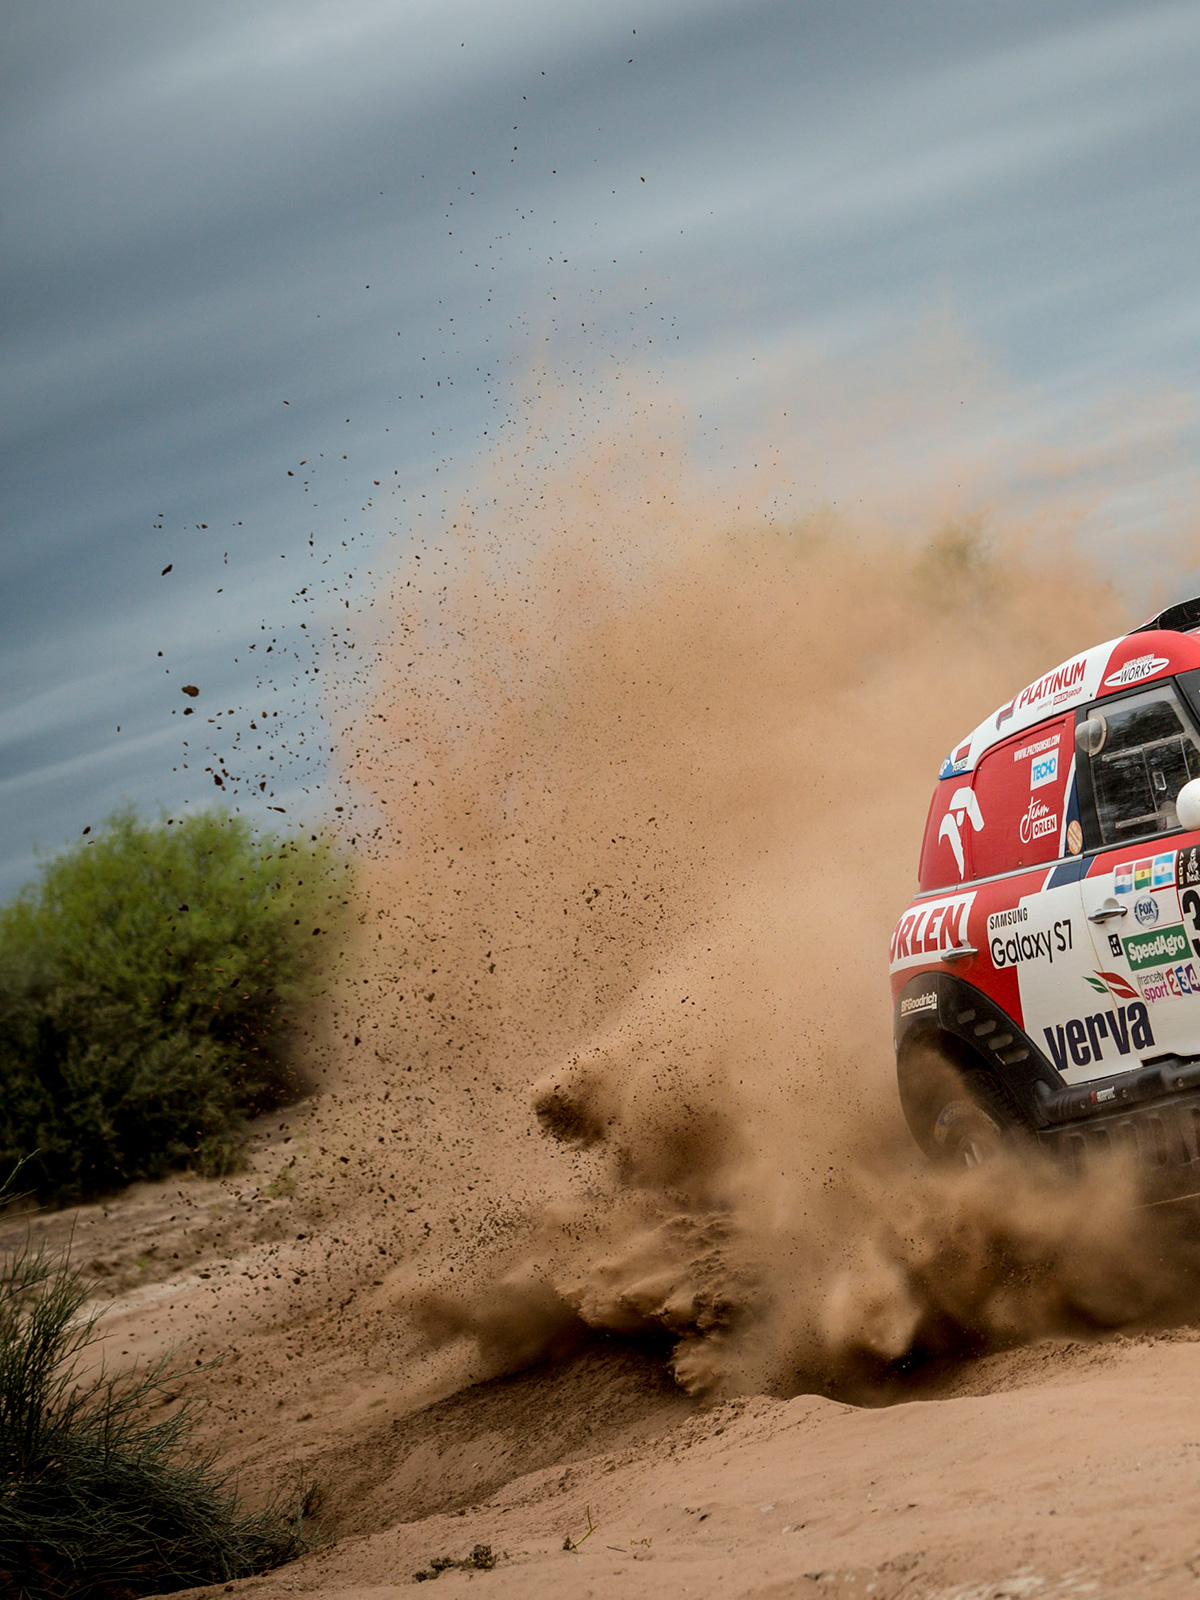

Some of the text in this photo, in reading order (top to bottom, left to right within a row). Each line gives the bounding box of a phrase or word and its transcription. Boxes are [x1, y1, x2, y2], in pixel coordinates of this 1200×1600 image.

[1120, 661, 1152, 683] WORKS
[1019, 659, 1087, 709] PLATINUM
[1033, 757, 1056, 782] TECHO
[1034, 816, 1056, 836] ORLEN
[990, 907, 1028, 930] SAMSUNG
[1139, 900, 1153, 915] FOX
[991, 930, 1053, 967] Galaxy
[1053, 919, 1073, 952] S7
[1128, 933, 1186, 963] SpeedAgro
[1169, 972, 1179, 992] 2
[1178, 971, 1188, 991] 3
[1189, 969, 1199, 989] 4
[901, 991, 937, 1012] BFGoodrich
[1144, 982, 1170, 1003] sport
[1043, 1001, 1156, 1071] verva
